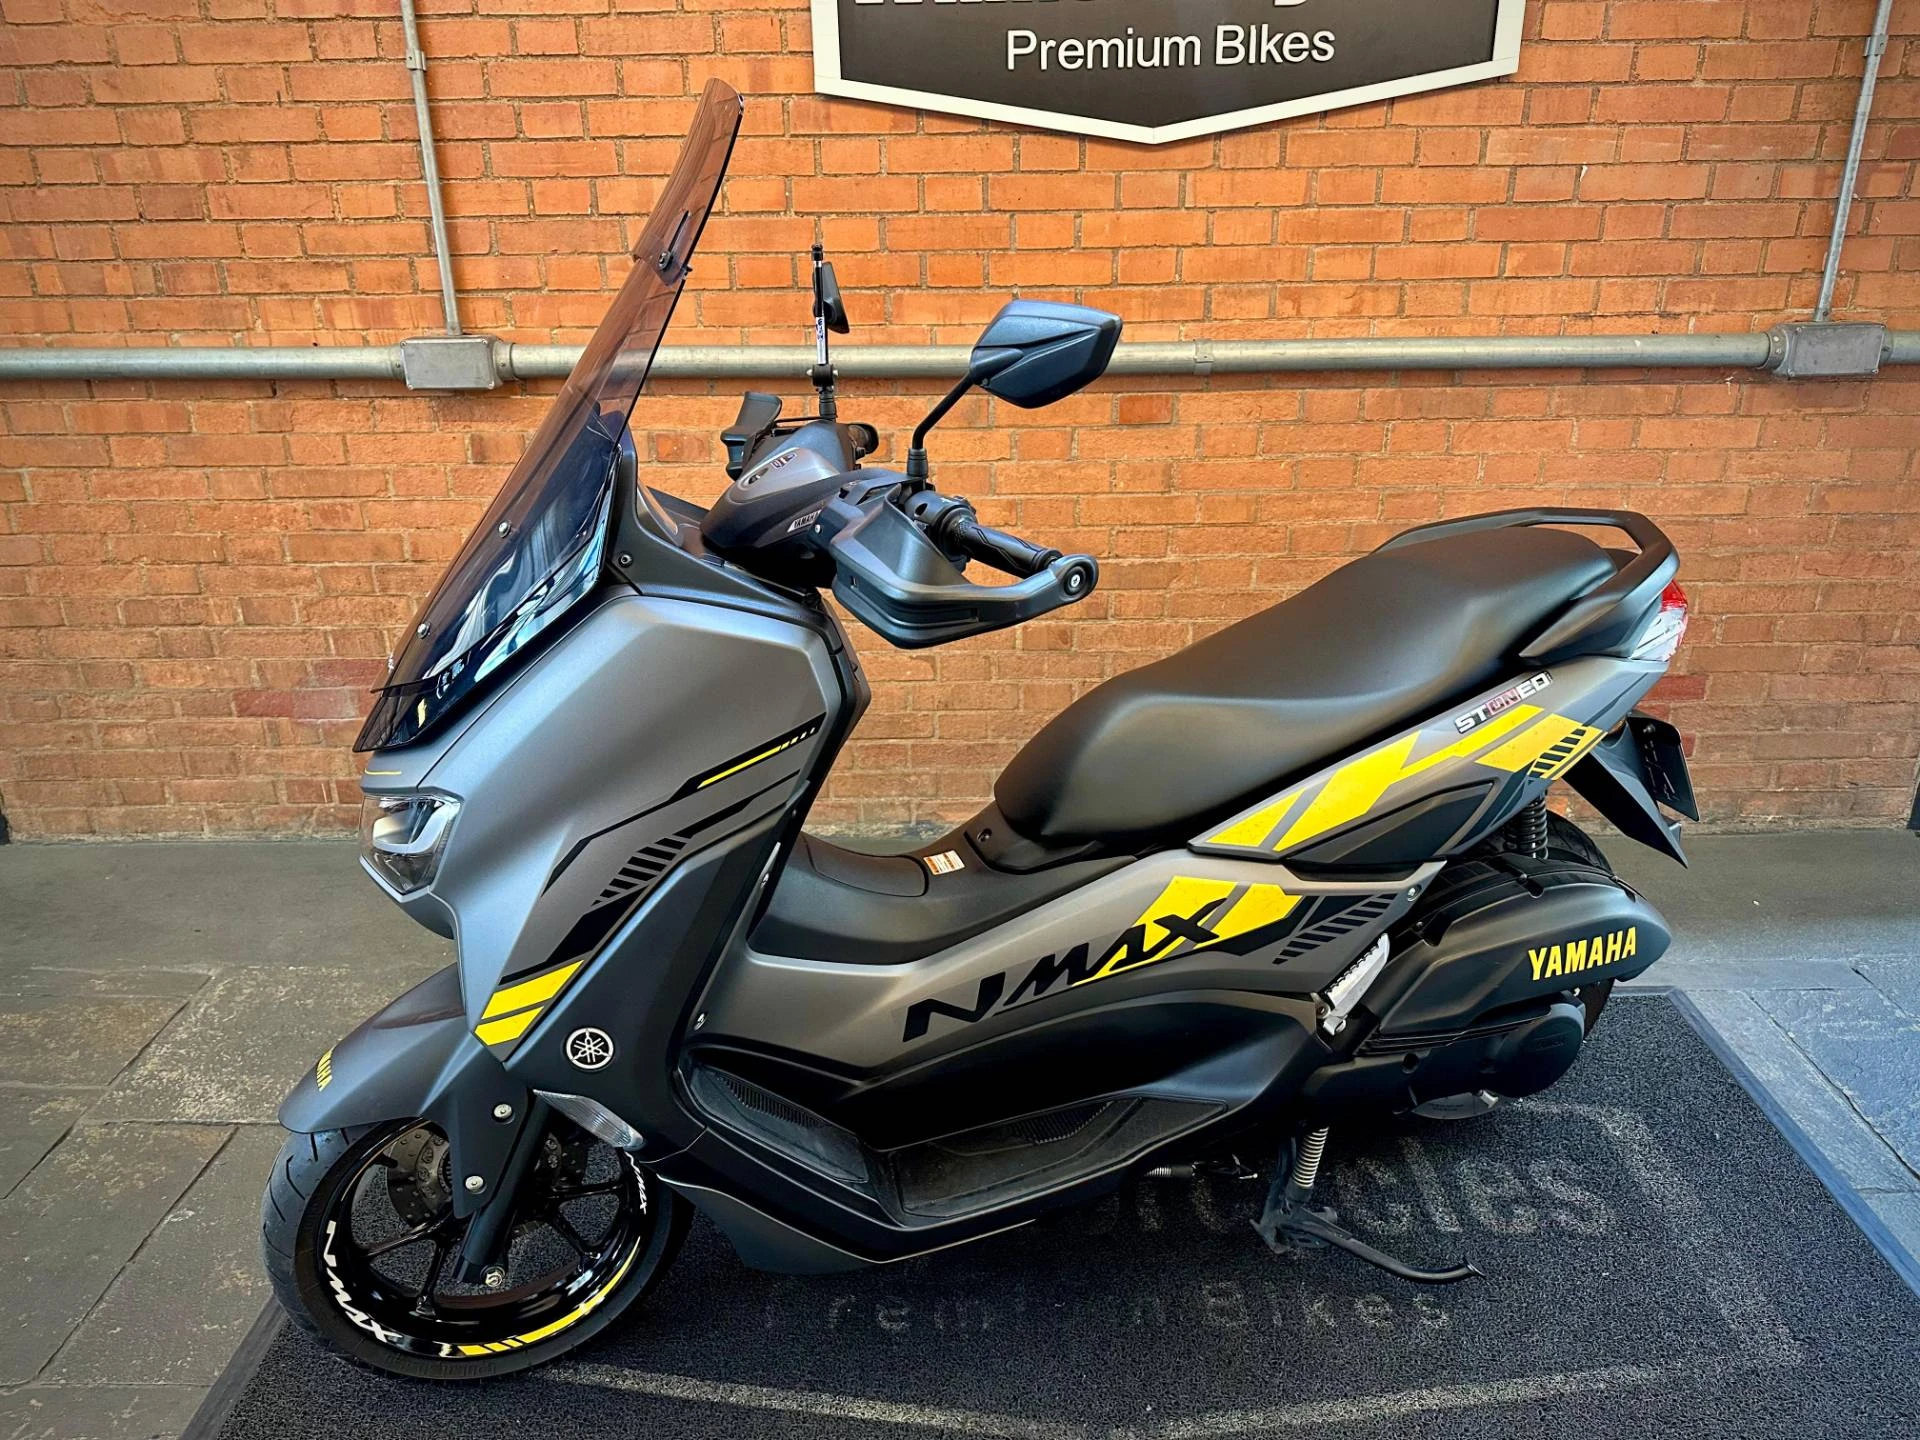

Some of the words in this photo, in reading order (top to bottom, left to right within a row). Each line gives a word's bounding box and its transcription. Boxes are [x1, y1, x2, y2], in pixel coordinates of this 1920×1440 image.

[1007, 27, 1202, 71] Premium
[902, 897, 1228, 1042] NMAX
[1528, 926, 1636, 981] YAMAHA
